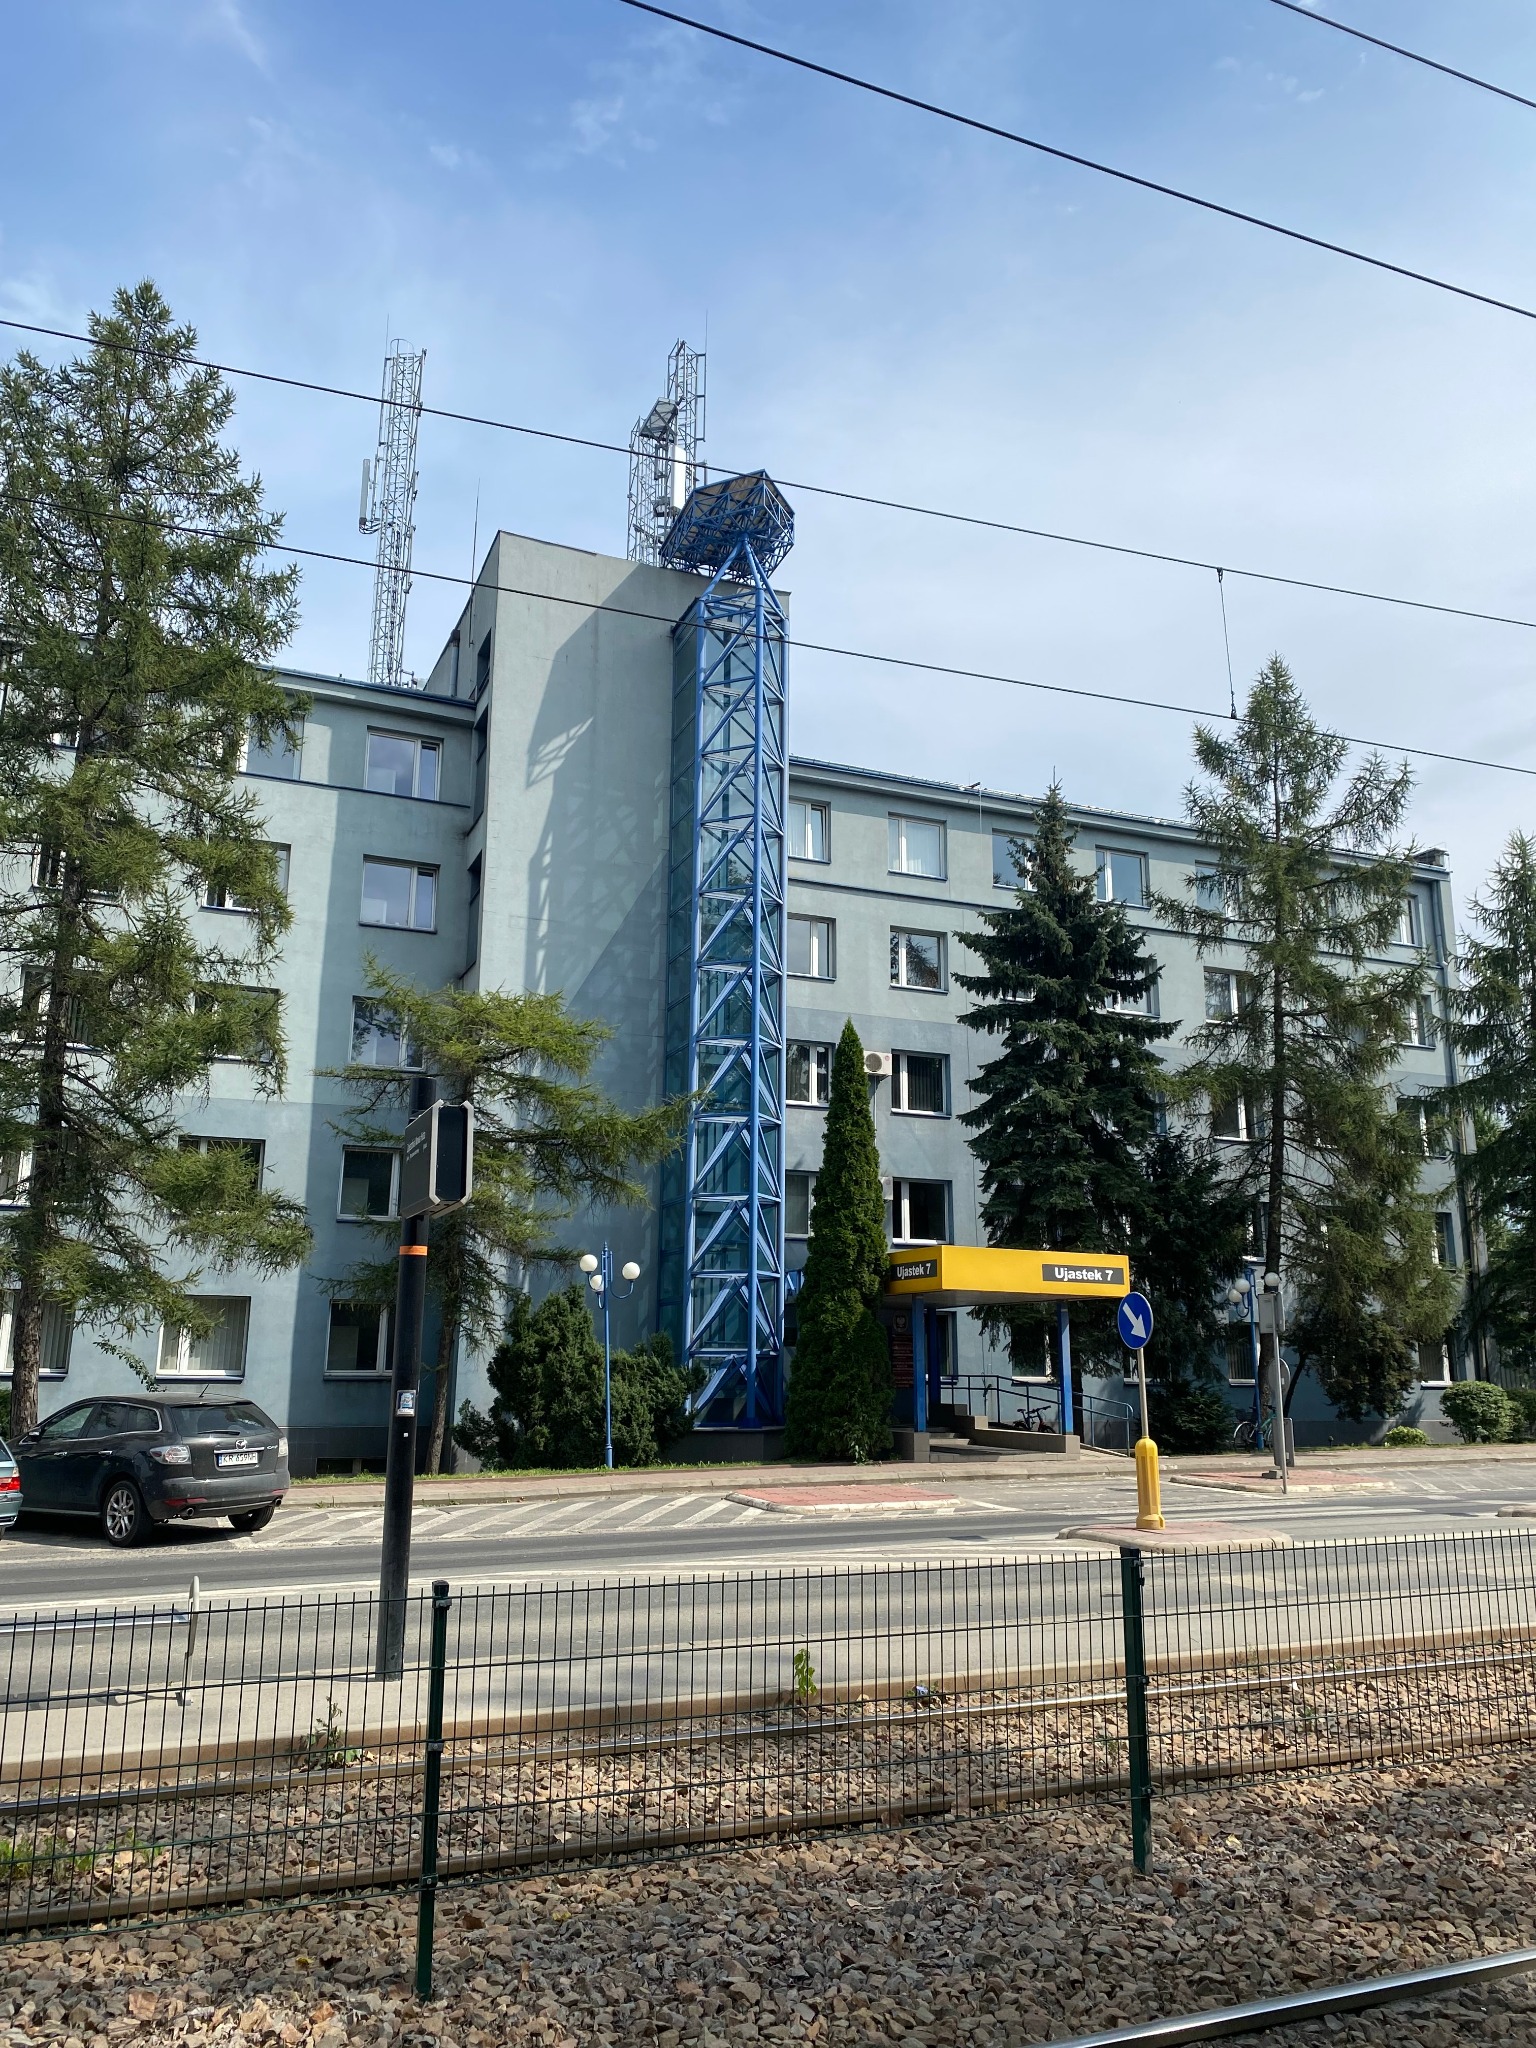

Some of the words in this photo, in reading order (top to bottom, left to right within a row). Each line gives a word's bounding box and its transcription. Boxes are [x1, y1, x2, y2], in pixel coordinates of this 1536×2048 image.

[896, 1264, 924, 1280] Ujastek
[925, 1262, 932, 1275] 7
[1054, 1267, 1103, 1282] Ujastek
[1105, 1269, 1114, 1281] 7
[223, 1454, 234, 1463] KR
